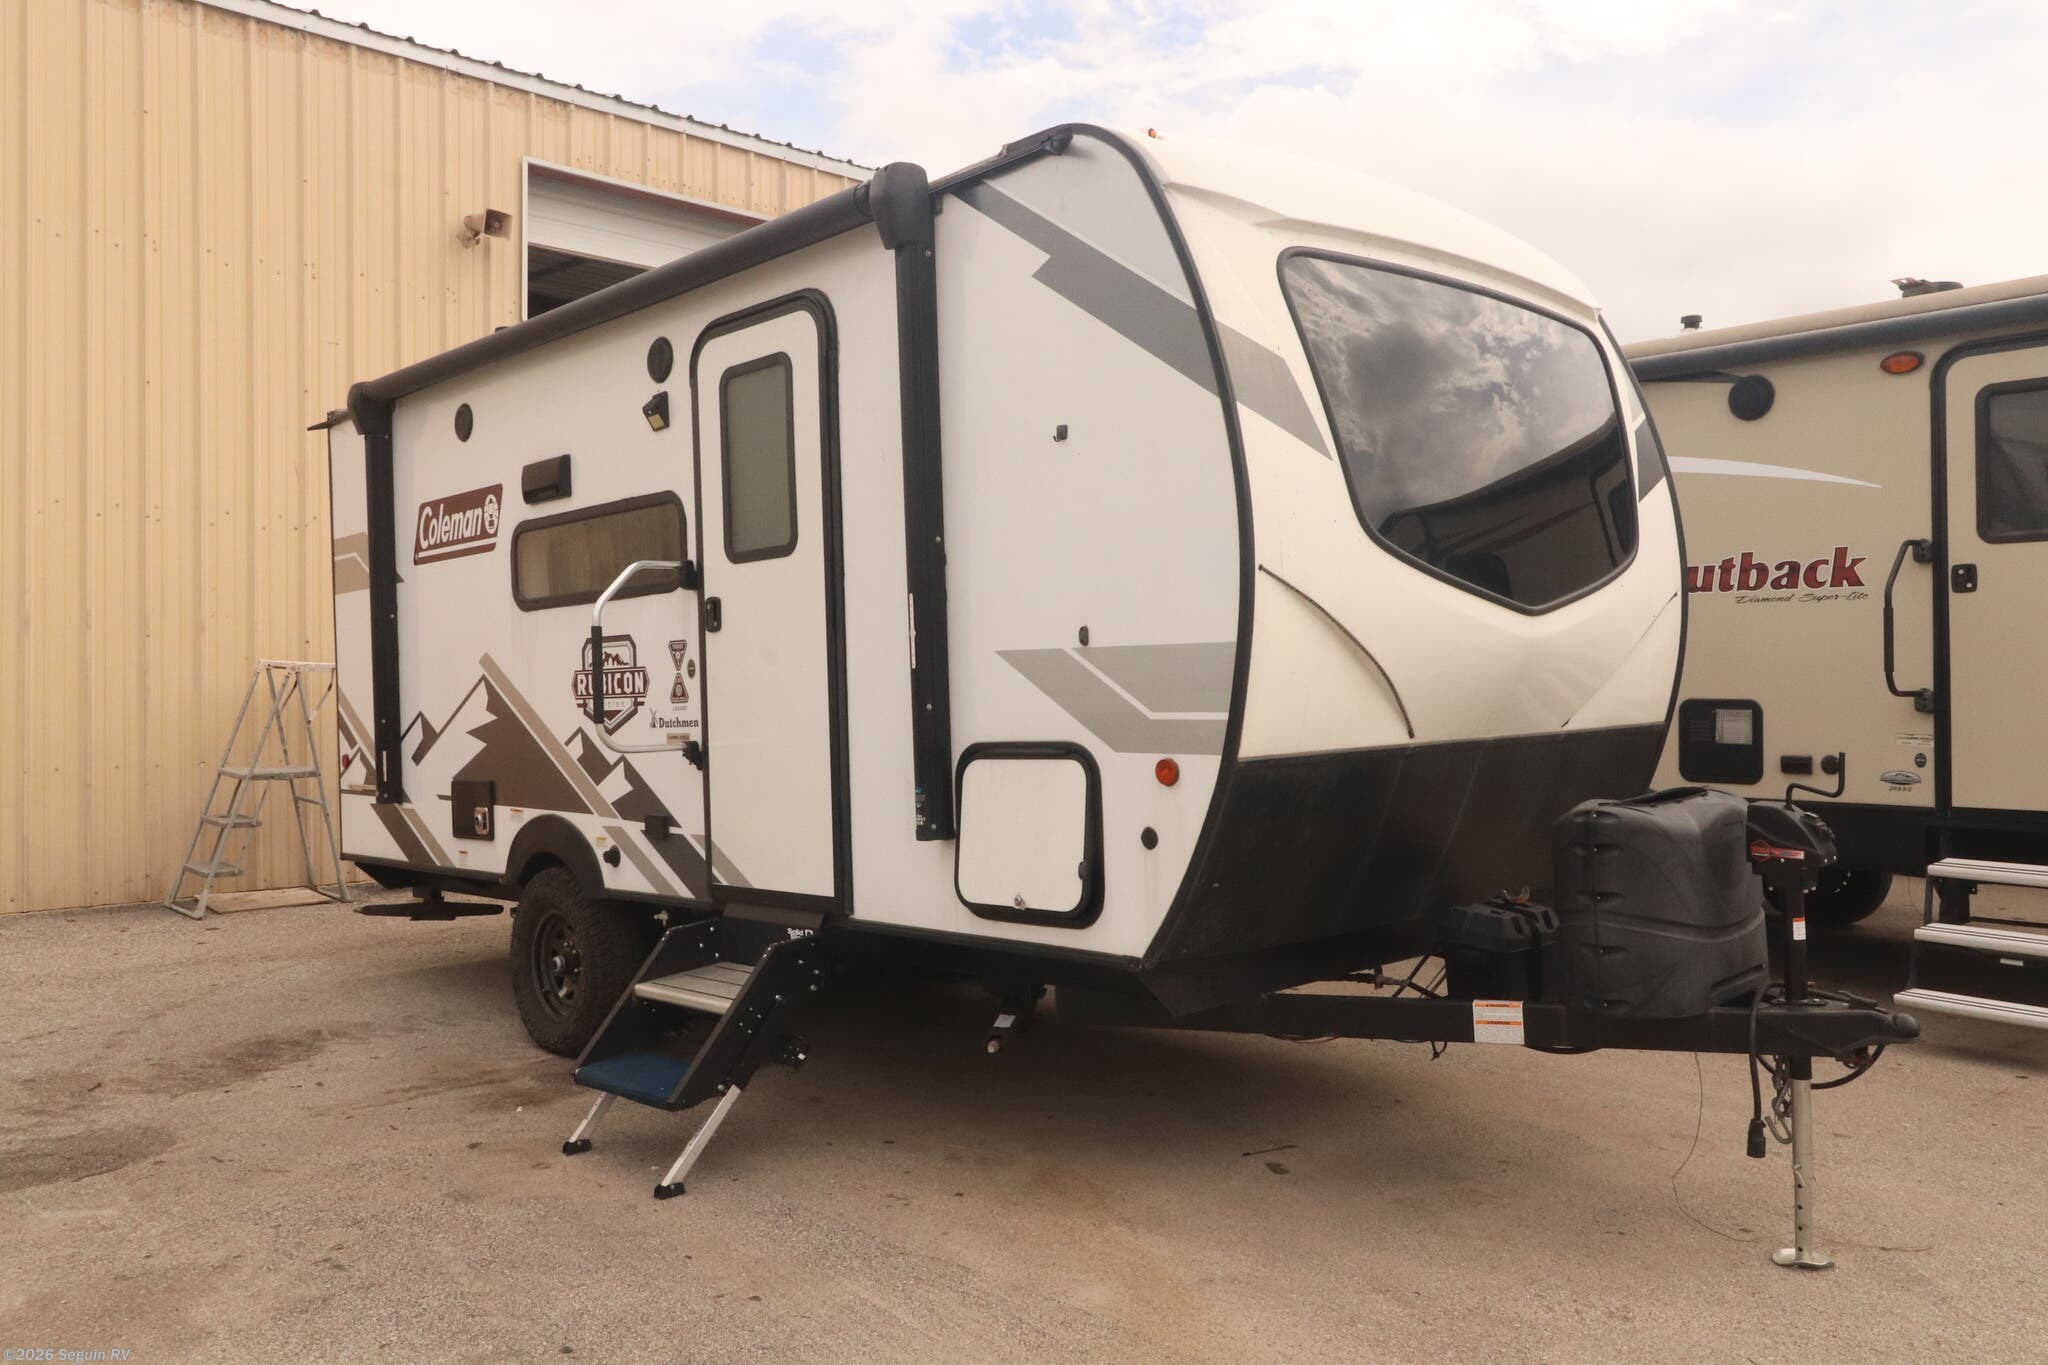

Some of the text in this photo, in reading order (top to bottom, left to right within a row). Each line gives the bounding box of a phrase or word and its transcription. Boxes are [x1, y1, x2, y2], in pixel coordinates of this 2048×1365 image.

[419, 503, 482, 549] Coleman
[1687, 546, 1866, 593] utback
[1736, 591, 1869, 604] Diamond Super-Lite
[658, 716, 699, 729] Dutchmen
